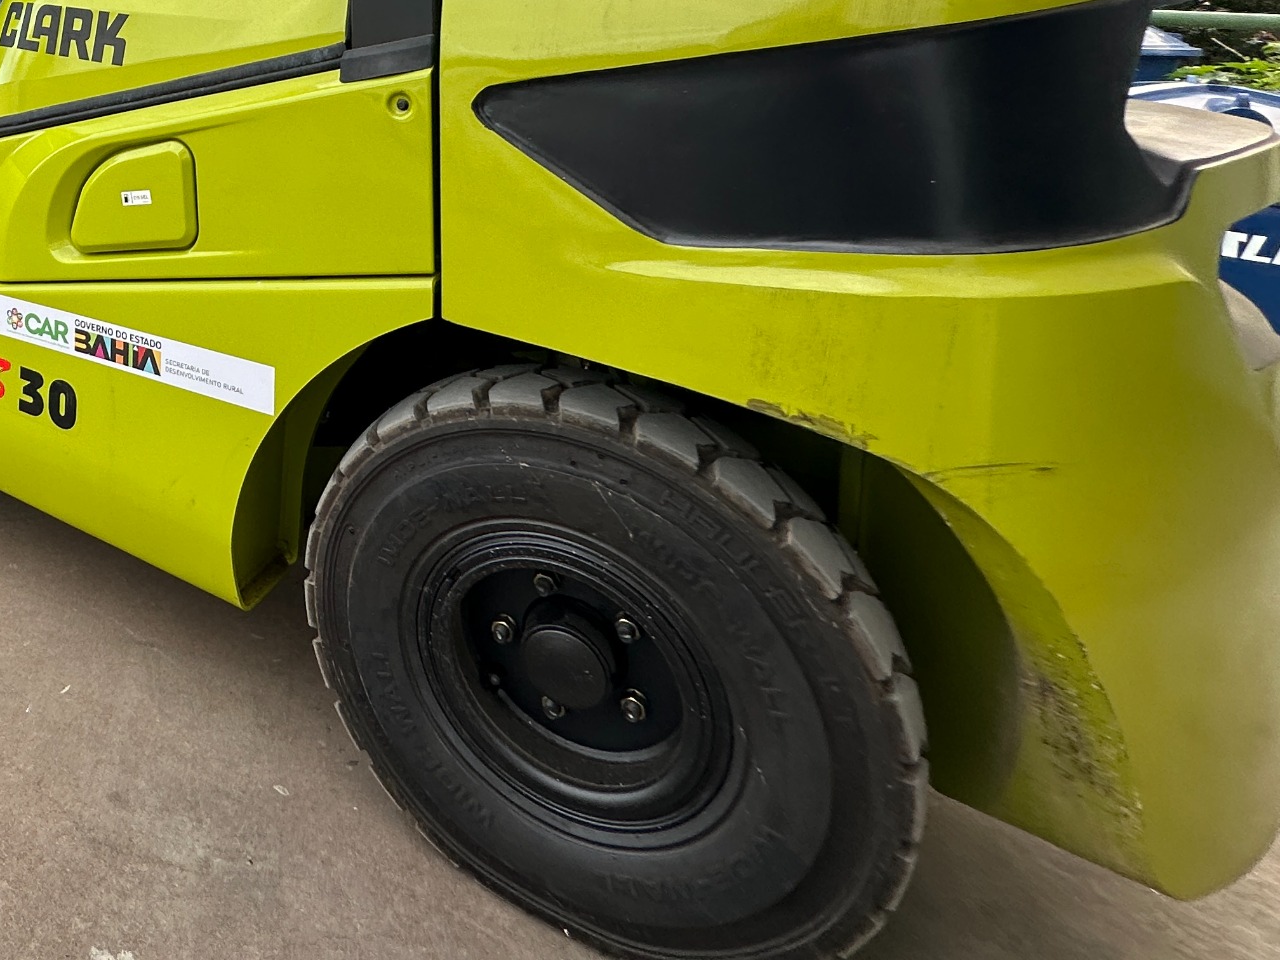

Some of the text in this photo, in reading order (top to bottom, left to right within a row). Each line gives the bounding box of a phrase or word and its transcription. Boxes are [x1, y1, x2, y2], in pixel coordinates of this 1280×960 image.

[0, 2, 130, 66] CLARK
[25, 313, 69, 344] CAR
[74, 319, 162, 349] GOVERNO DO ESTADO
[165, 359, 210, 376] SECRETARIA DE
[165, 366, 244, 394] DESENVOLVIMENTO RURAL
[19, 365, 77, 430] 30
